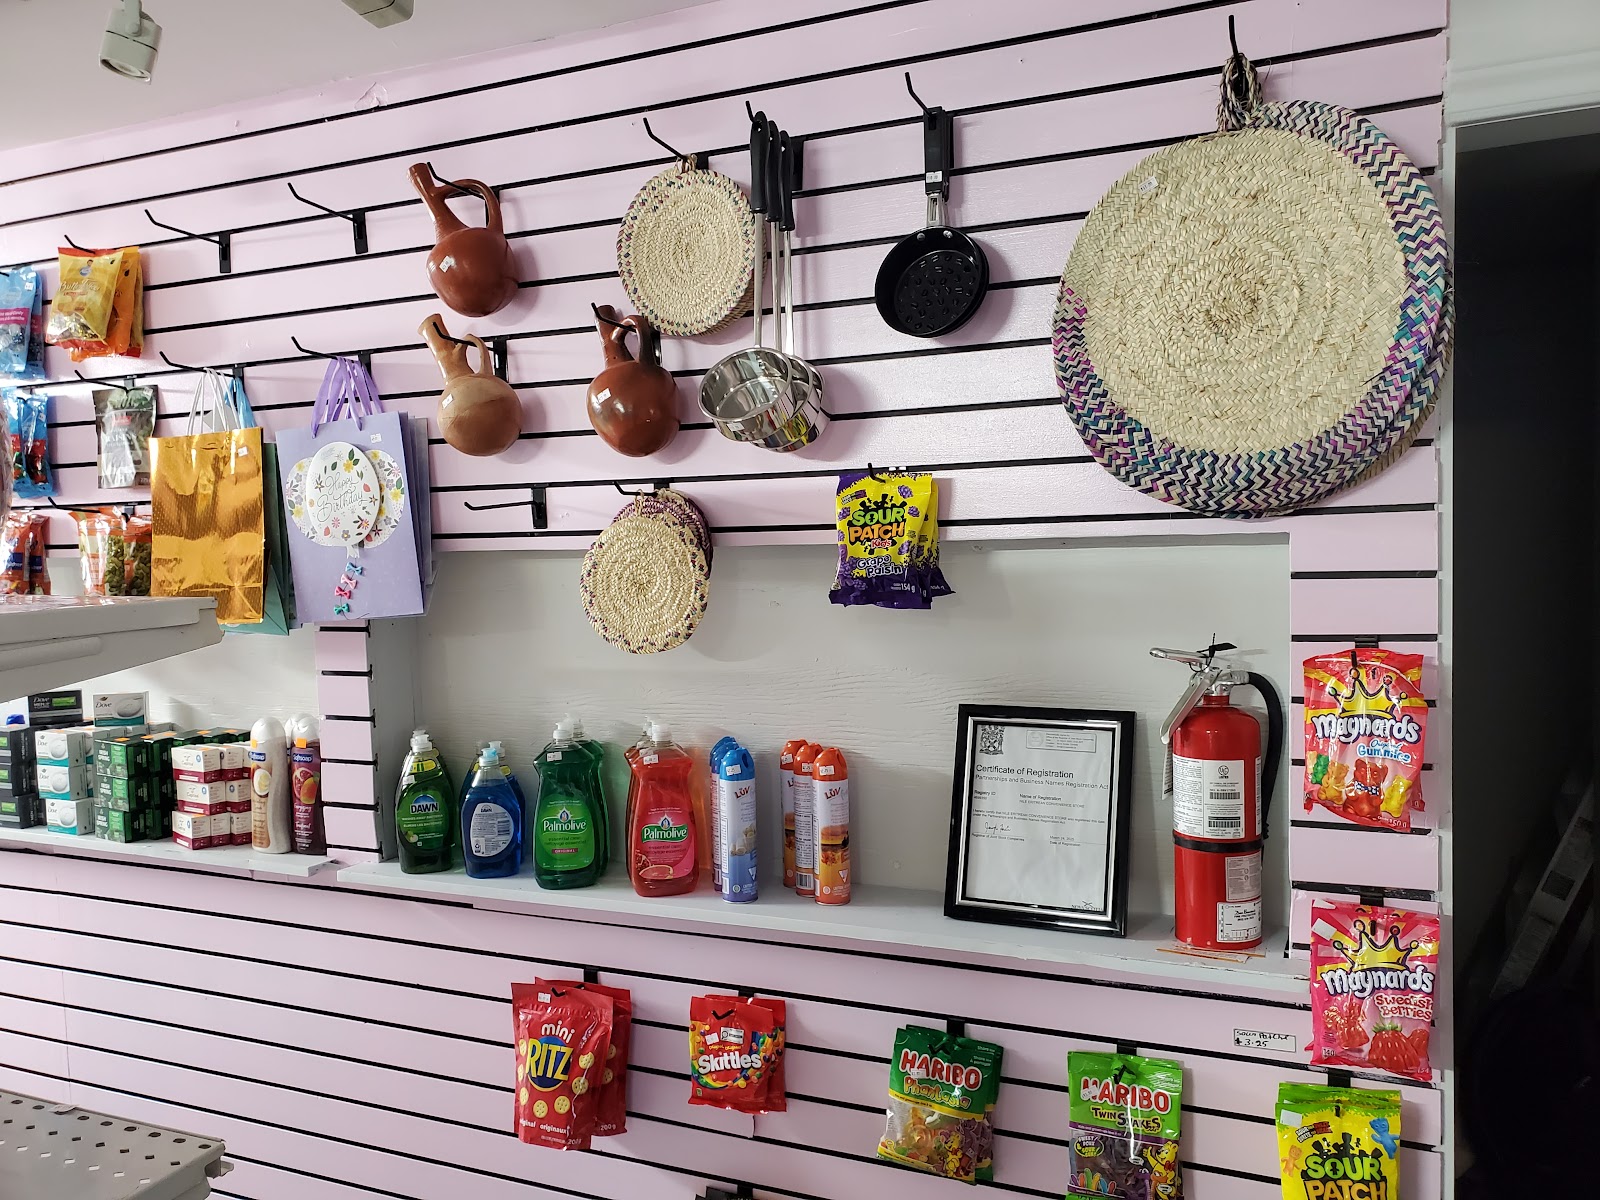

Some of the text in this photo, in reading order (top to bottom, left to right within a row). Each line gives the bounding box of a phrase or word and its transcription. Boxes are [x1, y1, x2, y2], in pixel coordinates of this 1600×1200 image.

[325, 472, 359, 495] Happy
[317, 486, 368, 522] Birthday
[852, 507, 905, 526] SOUR
[849, 521, 905, 543] PATCH
[857, 555, 892, 569] Grape
[867, 565, 903, 578] Raisin
[1311, 713, 1421, 744] Maynards
[976, 764, 1015, 775] Certificate
[1026, 767, 1074, 779] Registration
[975, 774, 1008, 783] Partnerships
[1065, 781, 1098, 789] Registration
[411, 803, 438, 814] DAWN
[543, 820, 586, 832] Palmolive
[644, 827, 687, 840] Palmolive
[1321, 966, 1435, 998] Maynards
[1375, 995, 1433, 1010] Swedish
[1381, 1005, 1432, 1020] Berries
[541, 1020, 575, 1043] mini
[526, 1038, 573, 1081] RITZ
[698, 1051, 762, 1075] Skittles
[901, 1050, 981, 1090] HARIBO
[1082, 1078, 1170, 1113] HARIBO
[1091, 1107, 1116, 1119] TWIN
[539, 1124, 567, 1135] originaux
[1306, 1155, 1381, 1181] SOUR
[1304, 1180, 1387, 1200] PATCH
